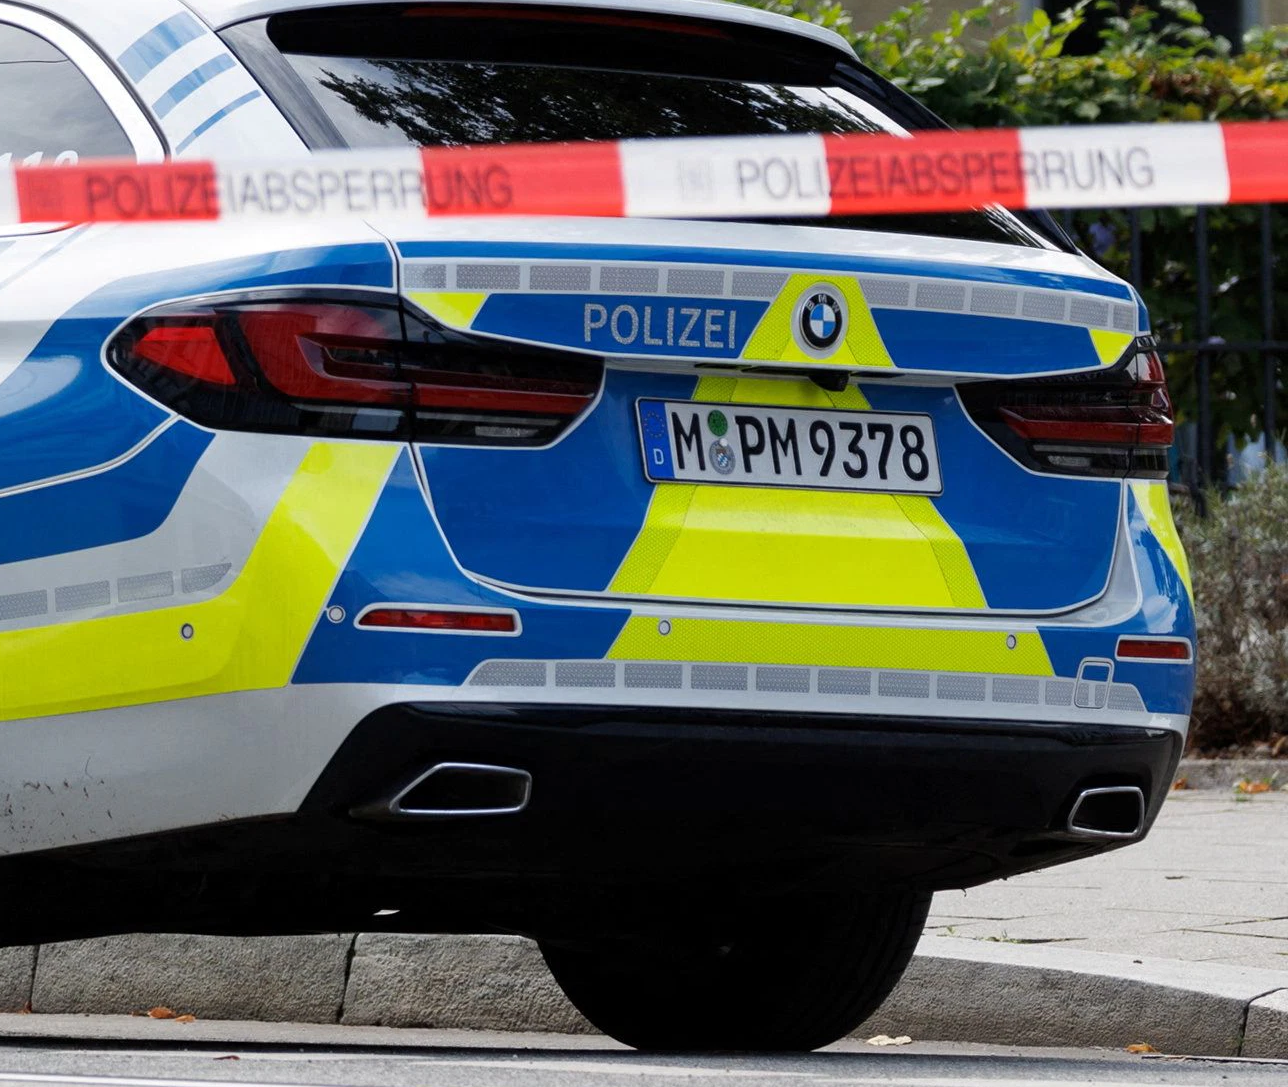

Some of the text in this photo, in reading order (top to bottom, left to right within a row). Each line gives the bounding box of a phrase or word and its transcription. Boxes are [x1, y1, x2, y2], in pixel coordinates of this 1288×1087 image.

[84, 166, 514, 214] POLIZEIABSPERRUNG
[735, 145, 1155, 200] POLIZEIABSPERRUNG
[583, 303, 737, 349] POLIZEI
[653, 448, 664, 465] D
[671, 411, 706, 471] M
[809, 420, 929, 482] 9378
